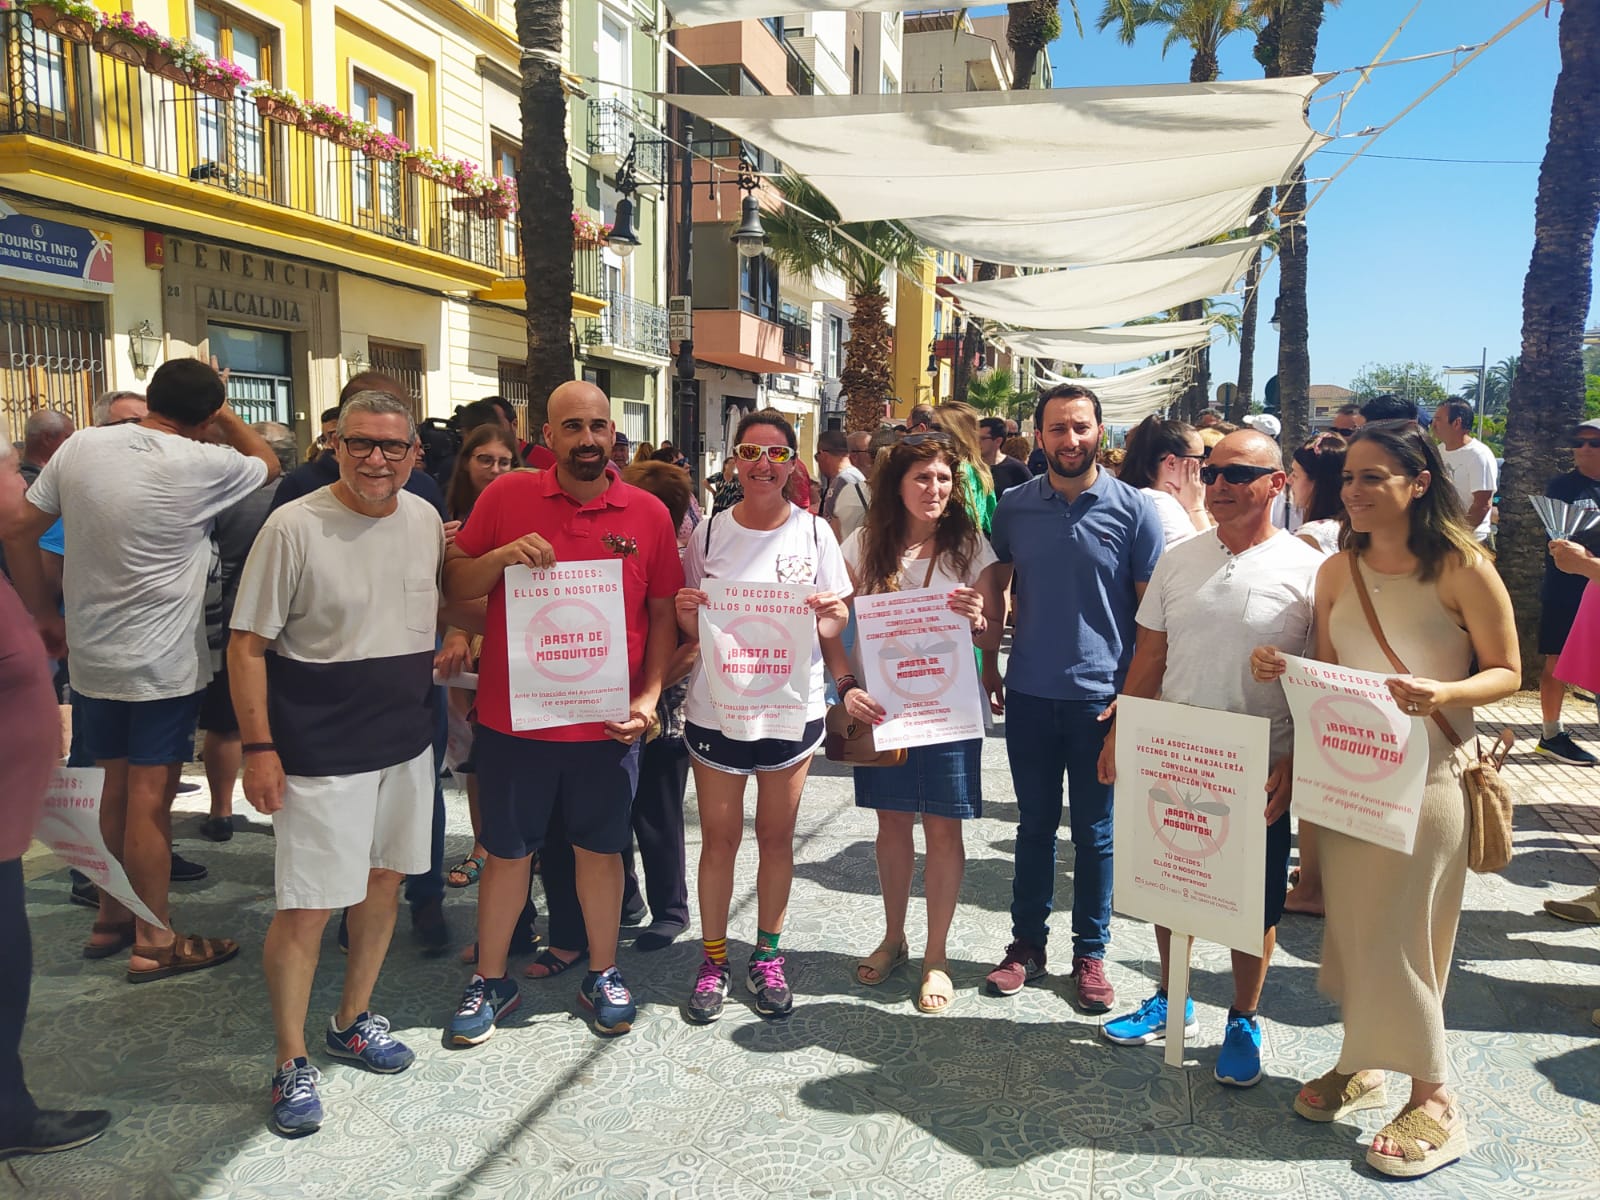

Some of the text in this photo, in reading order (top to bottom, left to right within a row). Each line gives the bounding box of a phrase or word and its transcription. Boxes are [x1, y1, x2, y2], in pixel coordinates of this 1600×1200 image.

[0, 233, 78, 258] TOURIST INFO
[22, 250, 34, 262] DE
[35, 253, 80, 270] CASTELLÓN
[169, 238, 329, 293] TENENCIA
[207, 287, 300, 322] ALCALDIA
[532, 569, 603, 581] TÚ DECIDES:
[514, 583, 618, 598] ELLOS O NOSOTROS
[725, 587, 796, 600] TÚ DECIDES:
[706, 602, 809, 616] ELLOS O NOSOTROS
[540, 631, 603, 648] ¡BASTA DE
[536, 646, 608, 661] MOSQUITOS!
[727, 648, 788, 660] ¡BASTA DE
[722, 663, 792, 674] MOSQUITOS!
[1302, 665, 1318, 676] TÚ
[1288, 676, 1393, 703] ELLOS O NOSOTR
[1327, 722, 1398, 745] ¡BASTA DE
[1136, 745, 1168, 757] VECINOS
[1183, 754, 1192, 762] LA
[1151, 737, 1237, 759] LAS ASOCIACIONES DE
[1322, 735, 1404, 765] MOSQUITOS!
[1161, 761, 1215, 778] CONVOCAN UNA
[1140, 768, 1237, 795] CONCENTRACIÓN VECINAL
[1165, 807, 1208, 824] ¡BASTA DE
[1163, 818, 1213, 837] MOSQUITOS!
[1153, 859, 1172, 869] ELLOS
[1178, 865, 1212, 880] NOSOTROS
[346, 1033, 369, 1055] N
